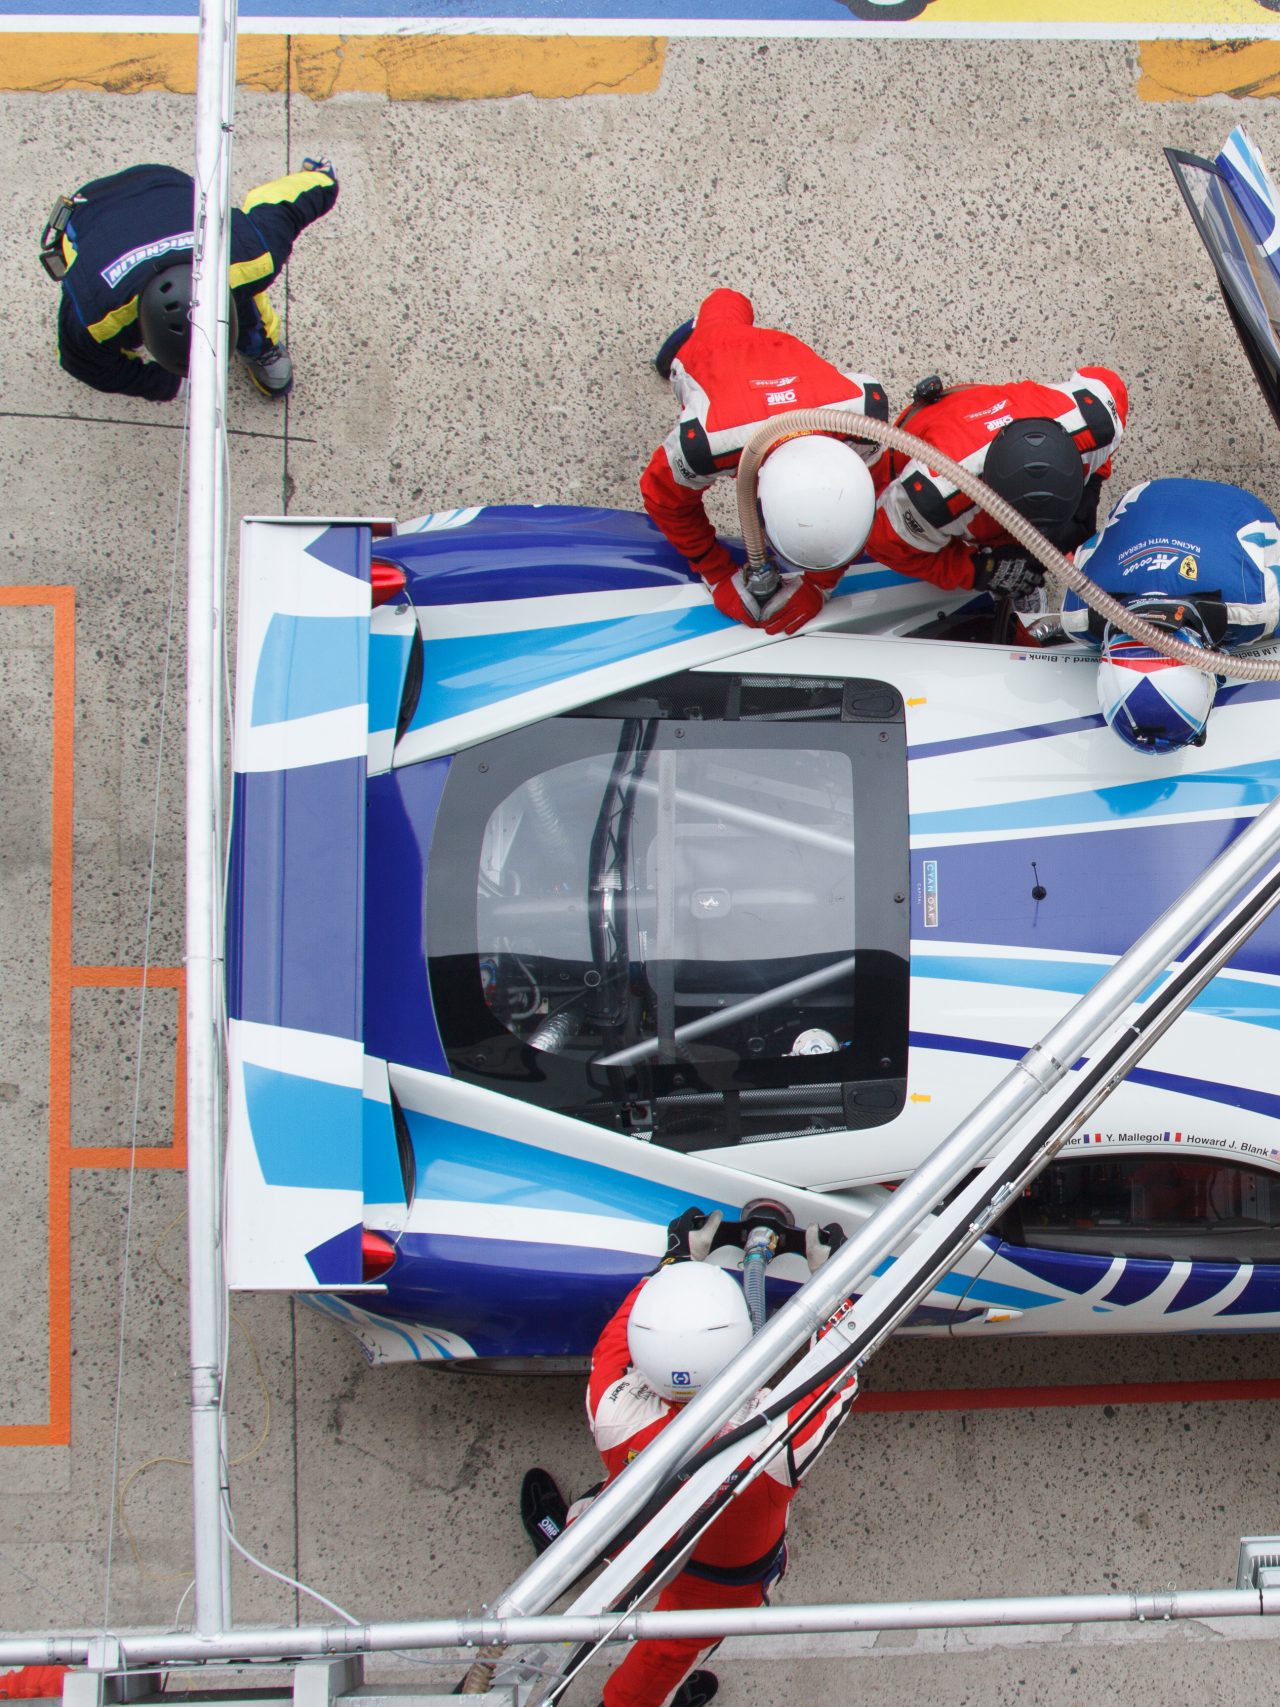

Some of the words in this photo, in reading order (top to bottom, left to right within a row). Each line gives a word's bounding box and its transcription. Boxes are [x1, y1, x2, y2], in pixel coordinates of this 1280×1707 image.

[109, 236, 194, 282] MICHELIN
[766, 389, 798, 405] OMP
[985, 414, 1014, 433] OMP
[902, 508, 924, 534] OMP
[1118, 540, 1147, 560] FERRARI
[1149, 537, 1169, 546] WITH
[1171, 538, 1201, 553] RACING
[1147, 553, 1179, 571] AF
[1028, 653, 1058, 663] Blank
[926, 864, 935, 892] CYAN
[927, 896, 935, 919] OAK
[1106, 1133, 1115, 1143] Y.
[1118, 1133, 1163, 1143] Mallegol
[1186, 1134, 1227, 1147] Howard
[1228, 1139, 1237, 1150] J.
[1241, 1142, 1269, 1157] Blank
[538, 1516, 560, 1541] OMP
